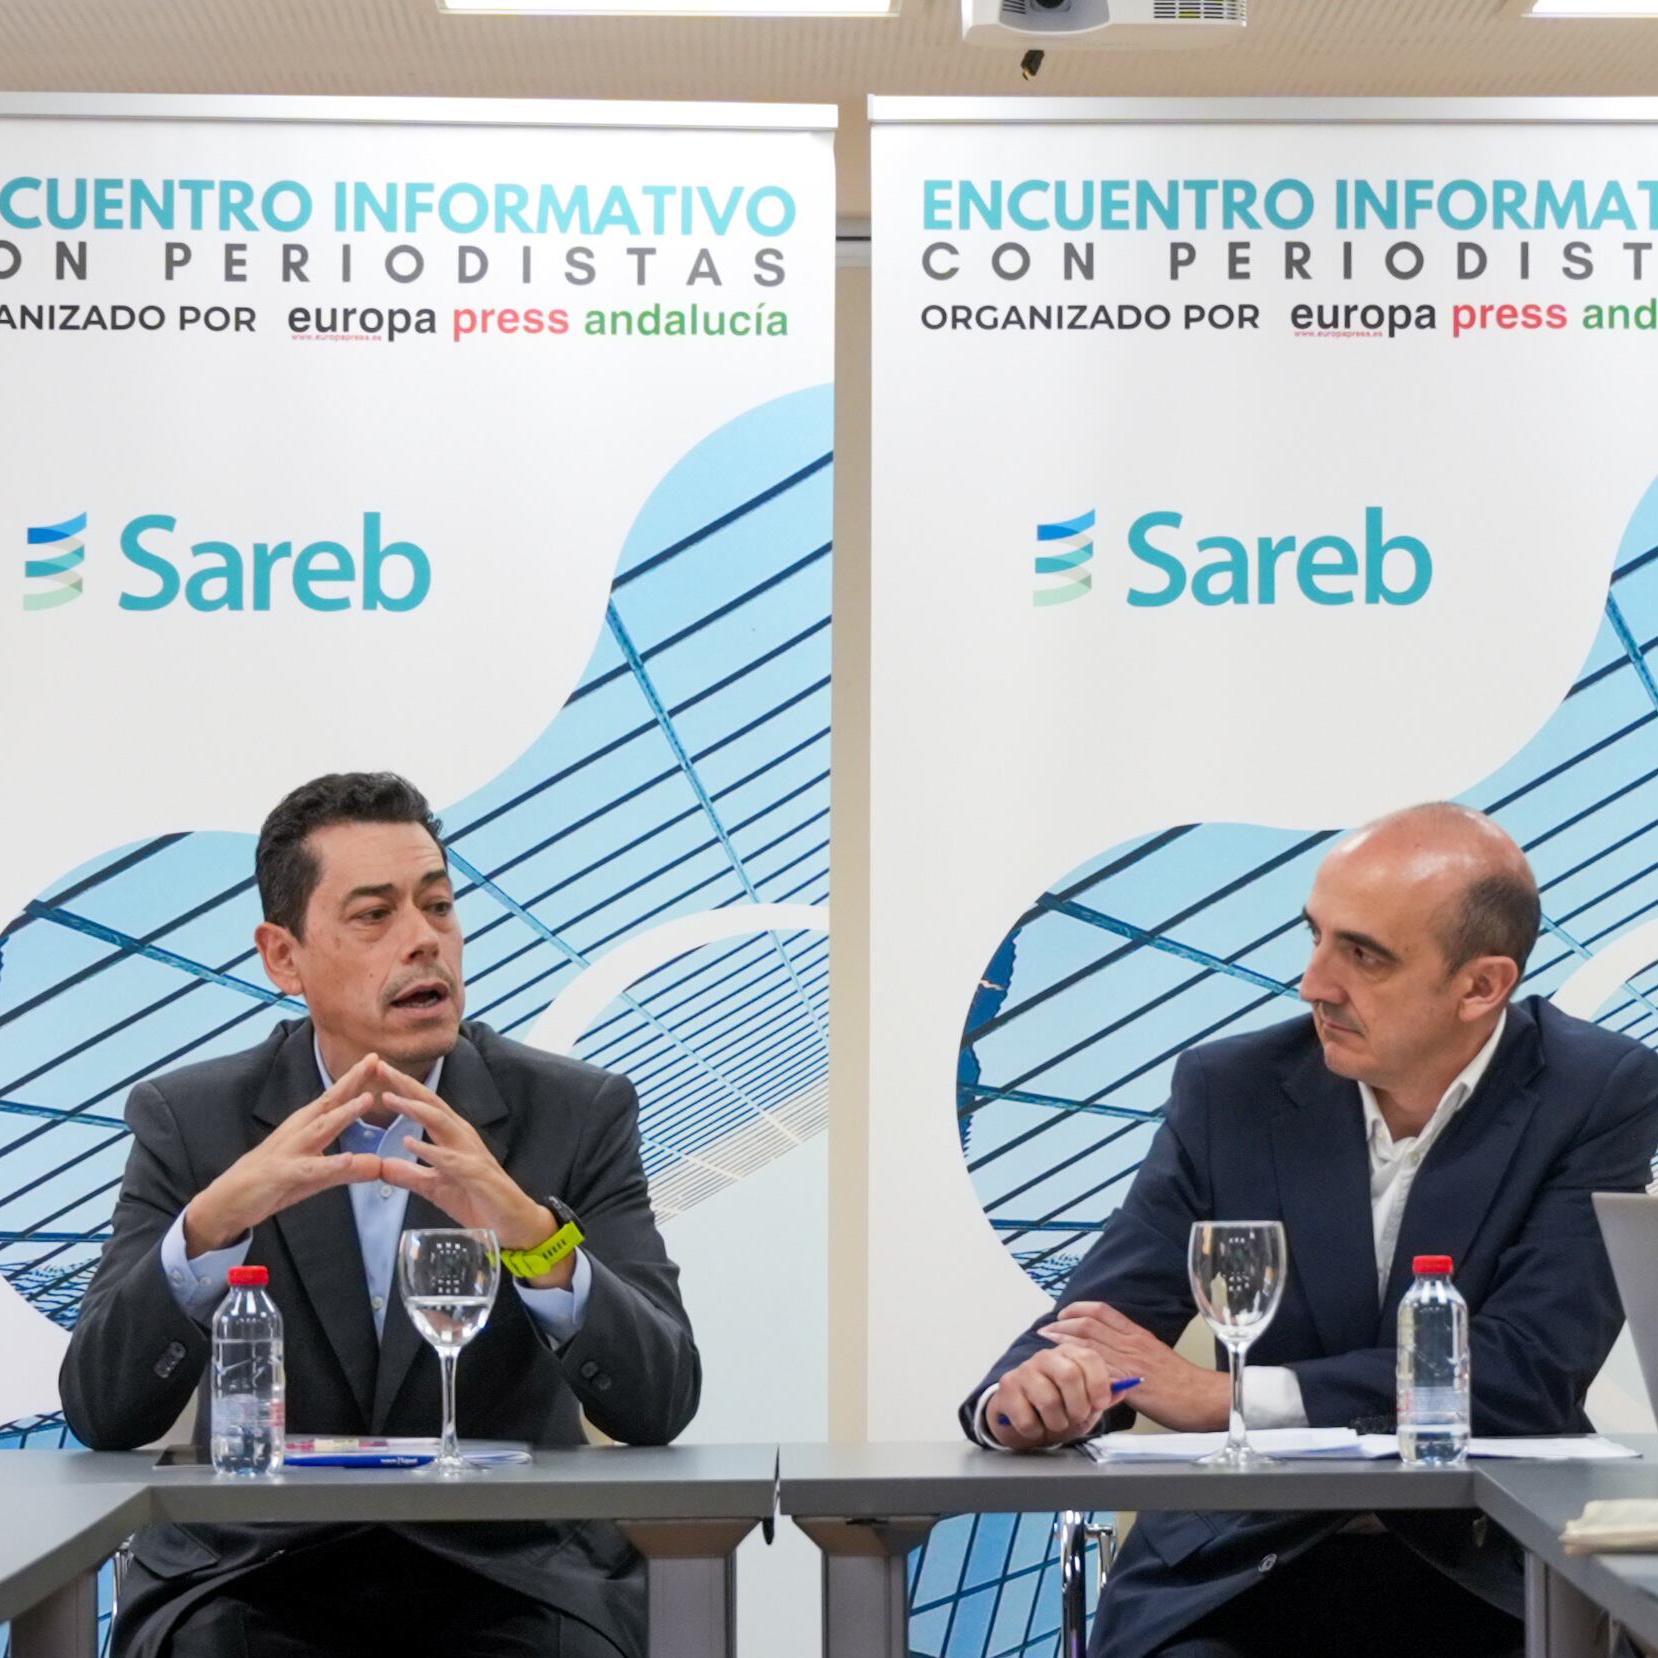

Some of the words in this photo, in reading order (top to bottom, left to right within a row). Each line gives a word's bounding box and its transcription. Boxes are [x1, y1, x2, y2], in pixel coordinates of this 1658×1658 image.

[335, 181, 796, 237] INFORMATIVO
[924, 178, 1314, 231] ENCUENTRO
[165, 242, 785, 287] PERIODISTAS
[922, 242, 1094, 281] CON
[180, 306, 256, 332] POR
[288, 307, 436, 342] europa
[454, 309, 569, 342] press
[585, 303, 788, 336] andalucía
[921, 305, 1171, 330] ORGANIZADO
[1185, 304, 1259, 329] POR
[1291, 304, 1436, 338] europa
[1453, 304, 1567, 338] press
[119, 512, 431, 612] Sareb
[1127, 507, 1433, 607] Sareb
